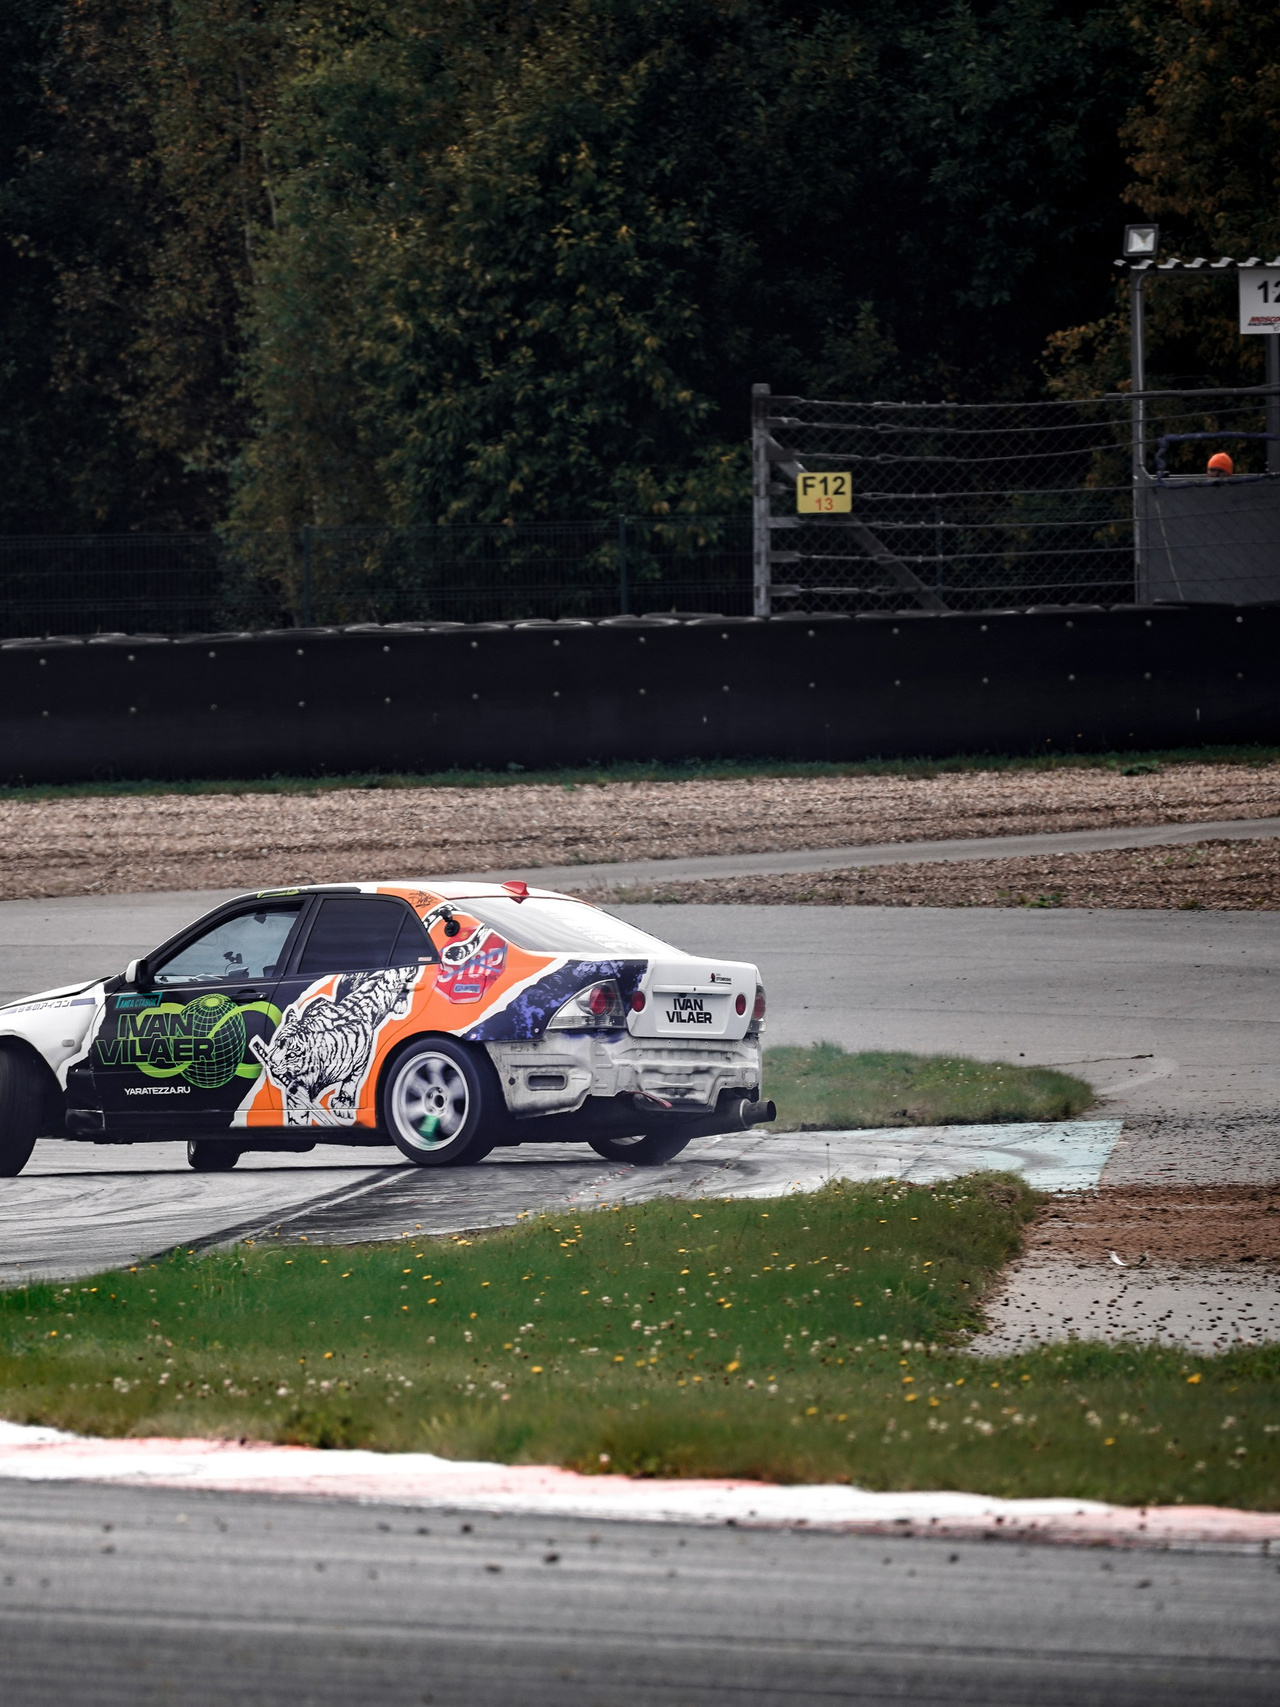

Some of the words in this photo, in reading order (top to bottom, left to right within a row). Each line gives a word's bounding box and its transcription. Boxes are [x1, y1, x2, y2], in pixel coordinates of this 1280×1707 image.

[802, 476, 846, 496] F12
[815, 497, 834, 511] 13
[673, 998, 704, 1011] IVAN
[666, 1010, 713, 1024] VILAER
[117, 1012, 196, 1039] IVAN
[96, 1037, 216, 1065] VILAER
[124, 1086, 191, 1096] YARATEZZA.RU
